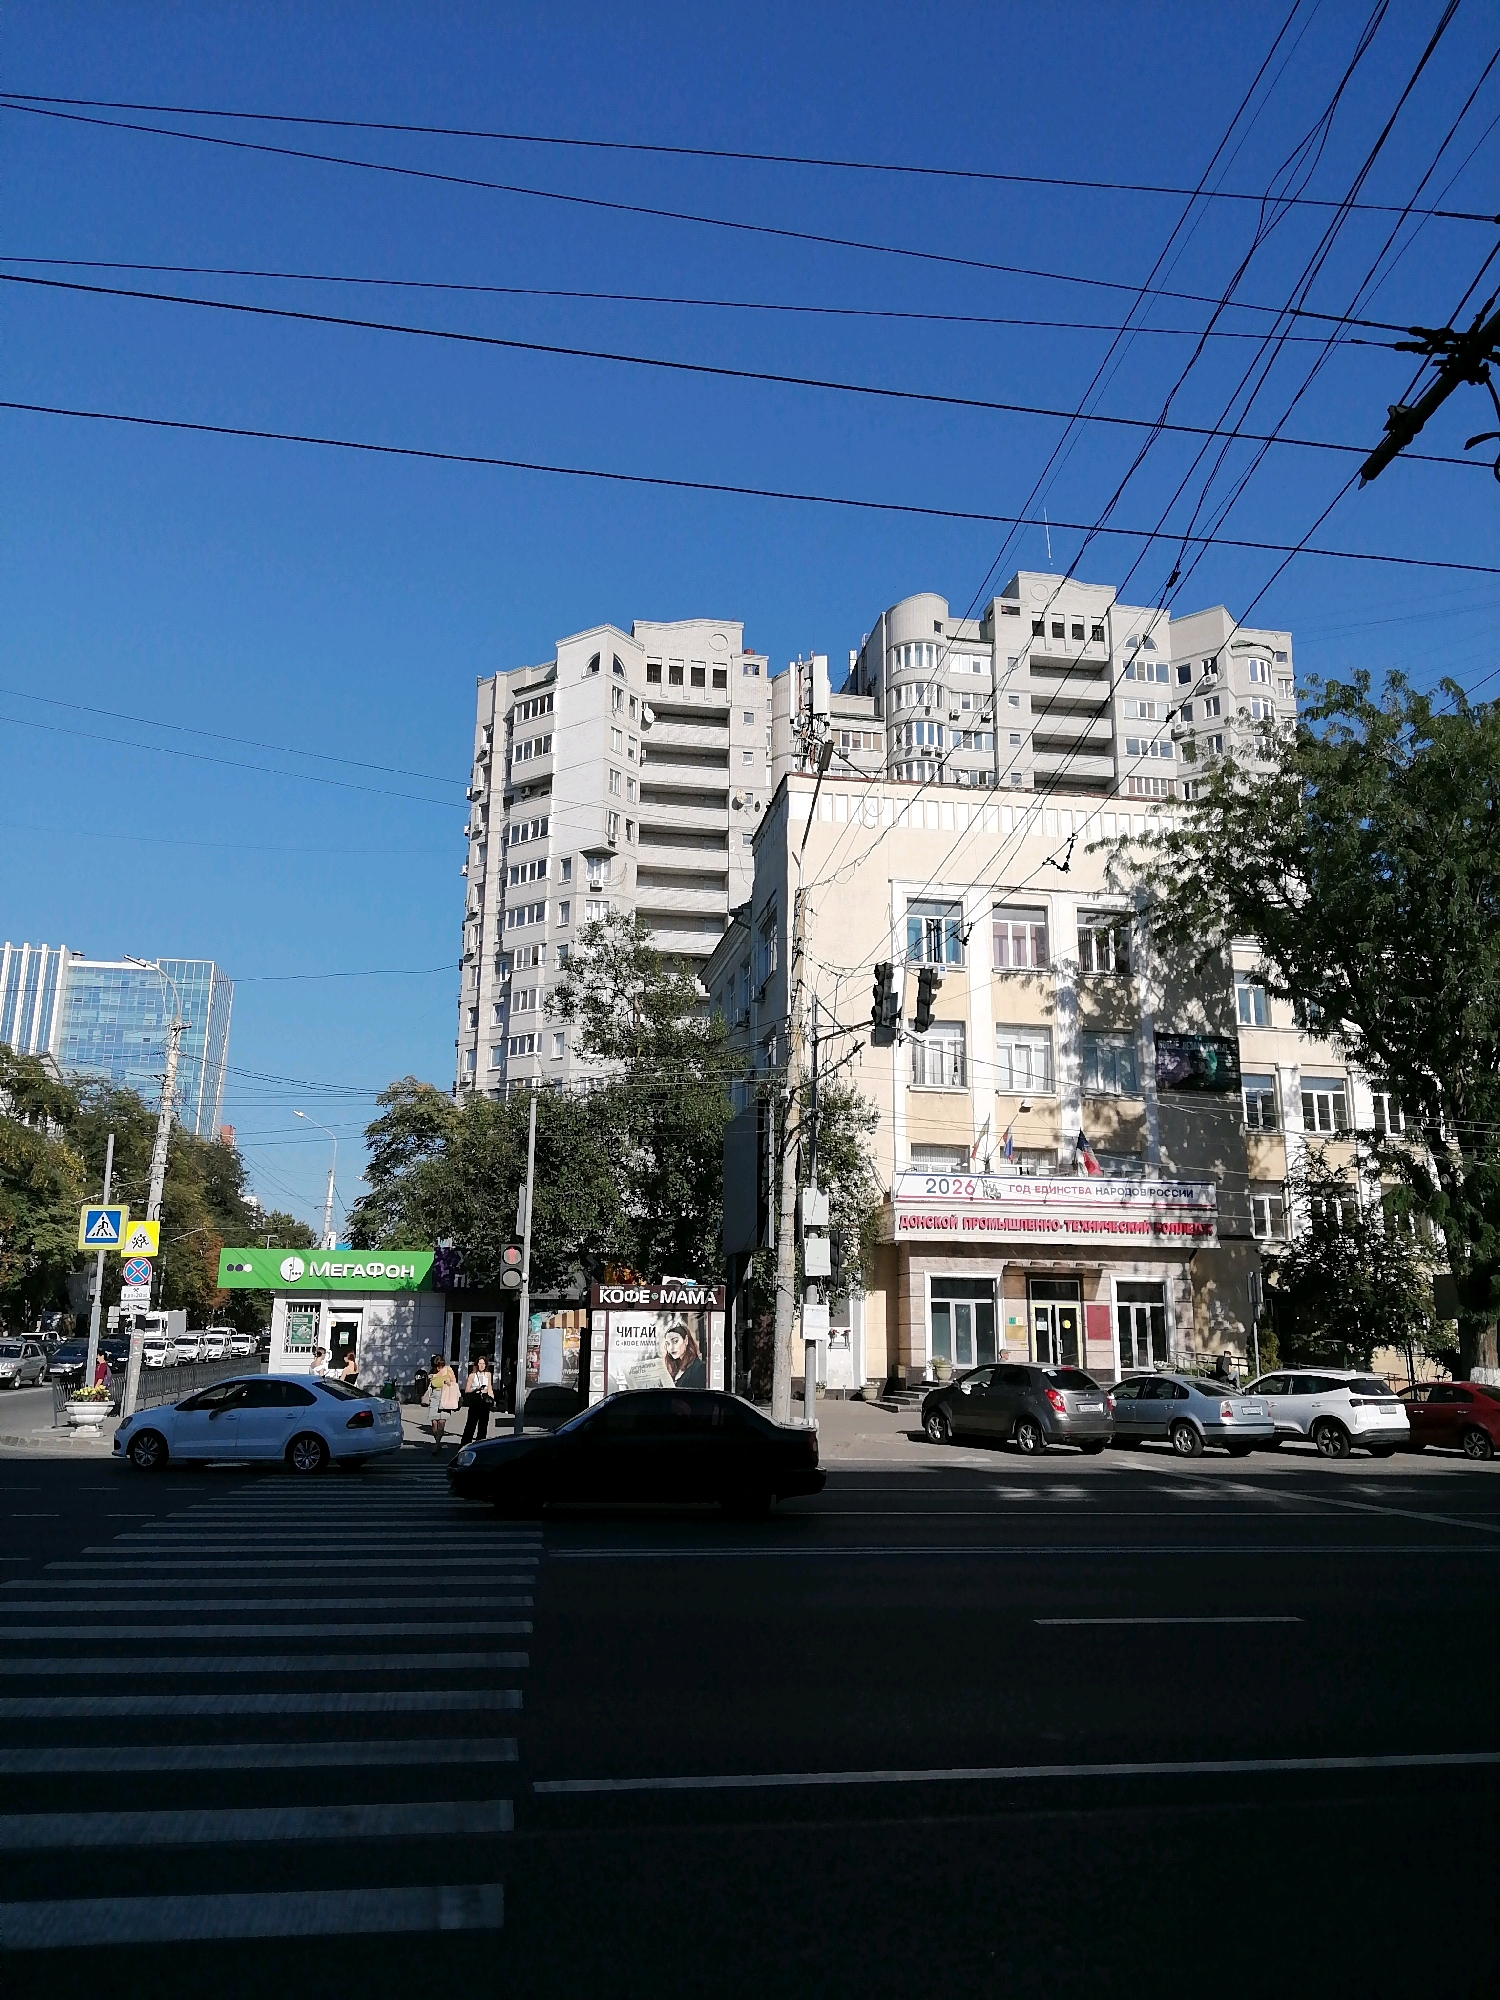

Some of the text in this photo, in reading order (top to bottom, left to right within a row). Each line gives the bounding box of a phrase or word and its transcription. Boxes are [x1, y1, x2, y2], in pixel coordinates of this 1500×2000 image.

[926, 1178, 1194, 1199] 2026 ГОД ЕДИНСТВА НАРОДОВ РОССИИ
[899, 1214, 958, 1230] ДОНСКОЙ
[962, 1216, 1150, 1234] ПРОМЫШЛЕННО-ТЕХНИЧЕСКИЙ
[599, 1289, 718, 1305] КОФЕ МАМА
[616, 1323, 657, 1338] ЧИТАЙ
[712, 1320, 723, 1391] ГАЗЕ
